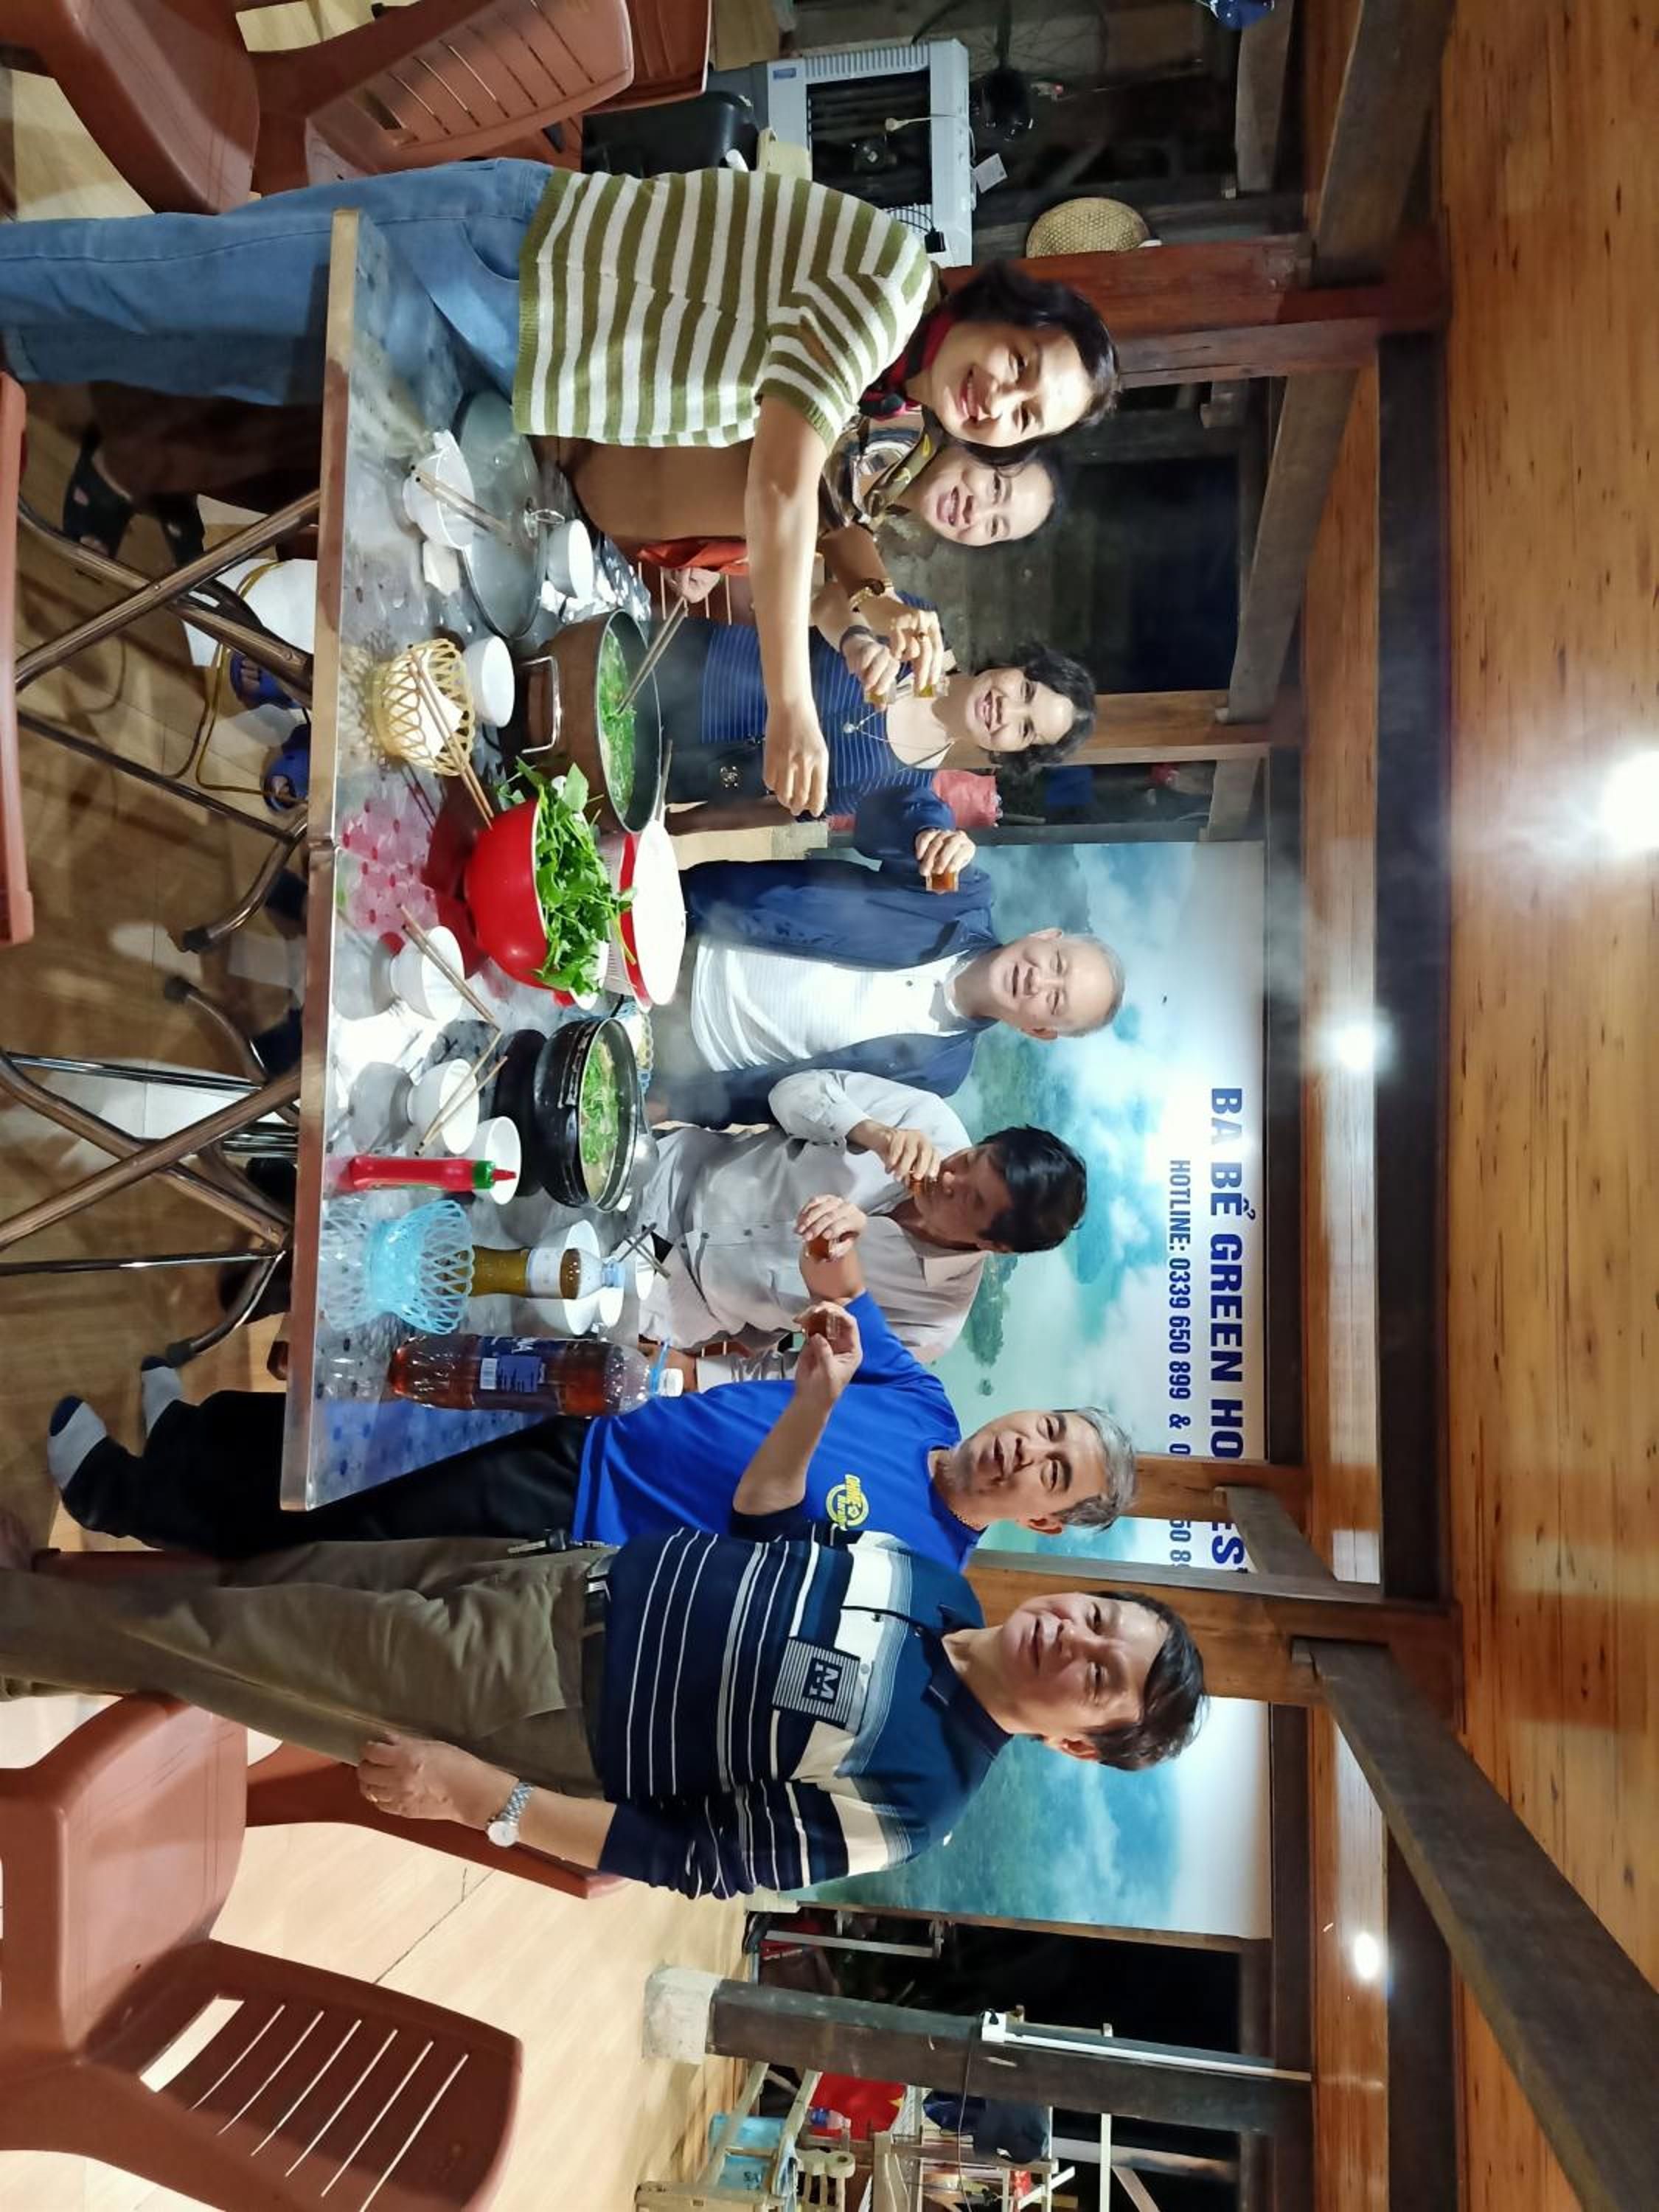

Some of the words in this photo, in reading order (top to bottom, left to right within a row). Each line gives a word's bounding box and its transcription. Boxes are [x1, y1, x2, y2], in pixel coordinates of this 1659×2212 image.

[1211, 1088, 1243, 1145] BA
[1169, 1159, 1191, 1251] HOTLINE:
[1211, 1161, 1256, 1220] BỂ
[1169, 1257, 1191, 1309] 0339
[1210, 1233, 1244, 1382] GREEN
[1169, 1315, 1191, 1354] 650
[1169, 1360, 1192, 1400] 899
[1169, 1413, 1192, 1430] &
[808, 1661, 839, 1700] M
